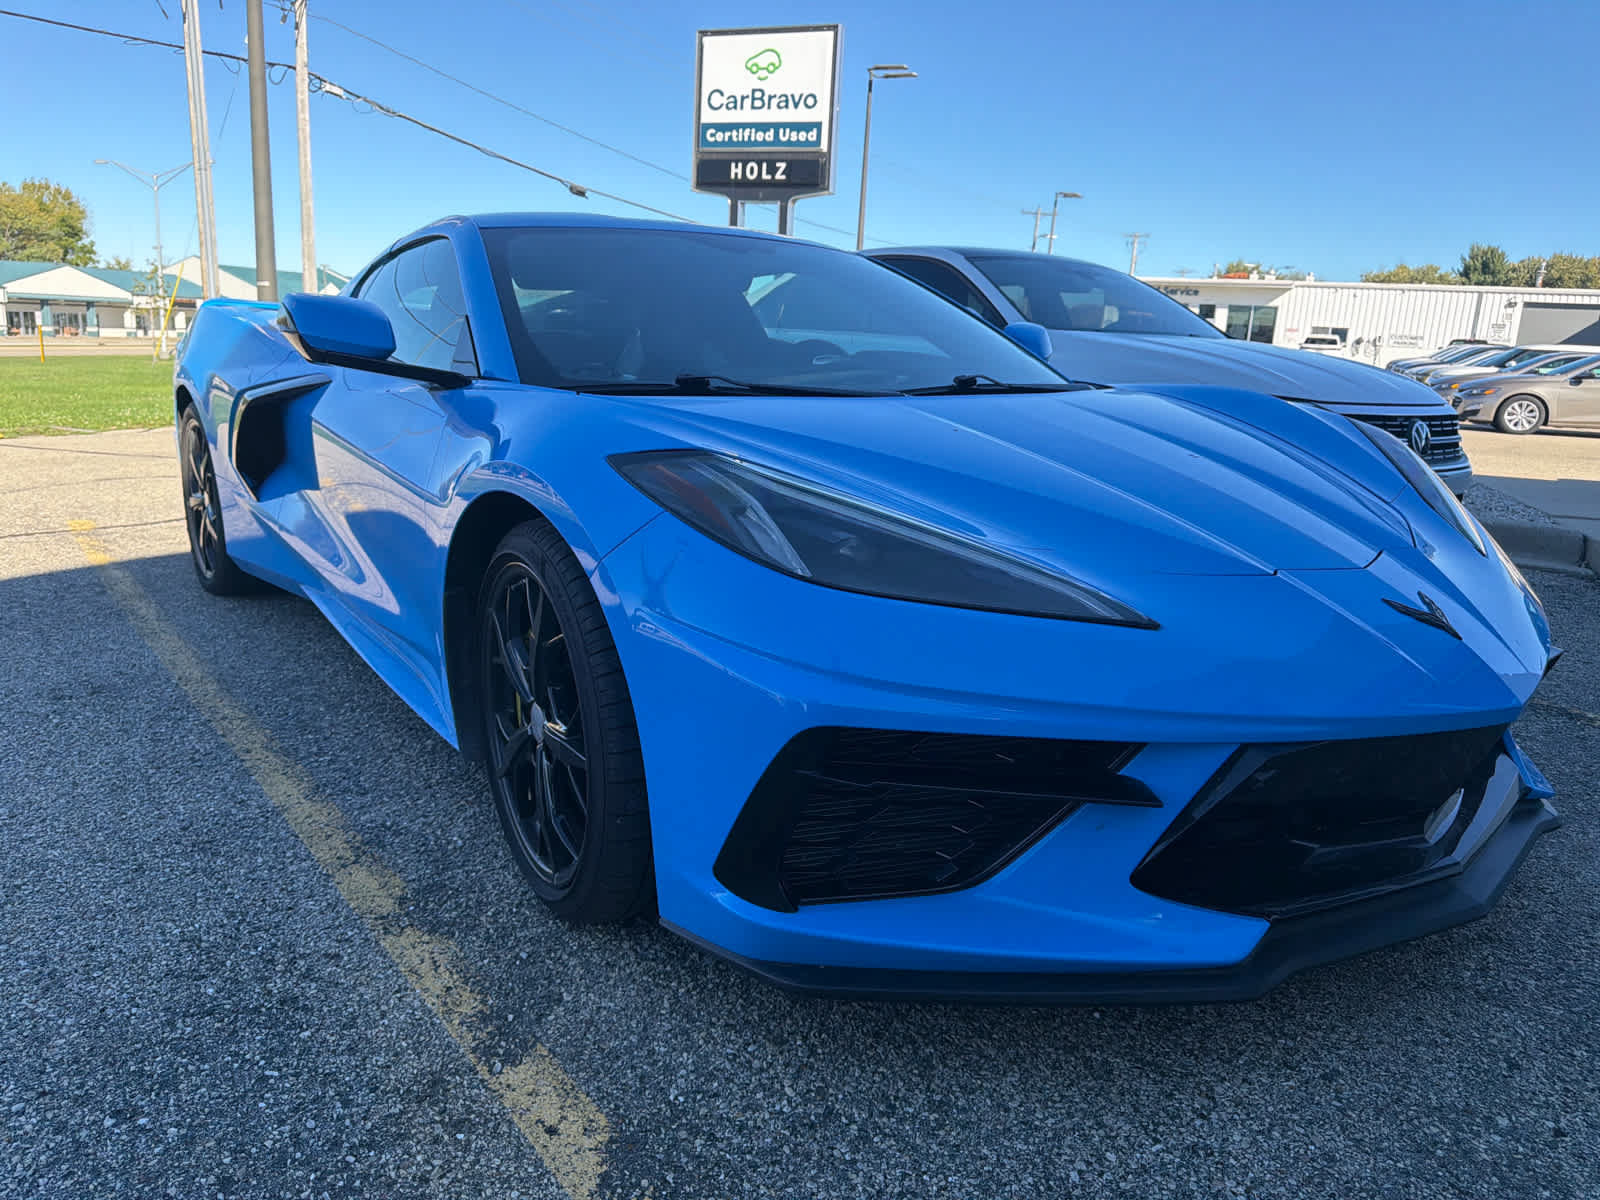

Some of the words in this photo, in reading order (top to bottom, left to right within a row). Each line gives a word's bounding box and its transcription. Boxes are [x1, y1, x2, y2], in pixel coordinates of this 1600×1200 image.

[707, 88, 818, 111] CarBravo
[706, 128, 775, 142] Certified
[779, 127, 817, 142] Used
[730, 162, 788, 180] HOLZ
